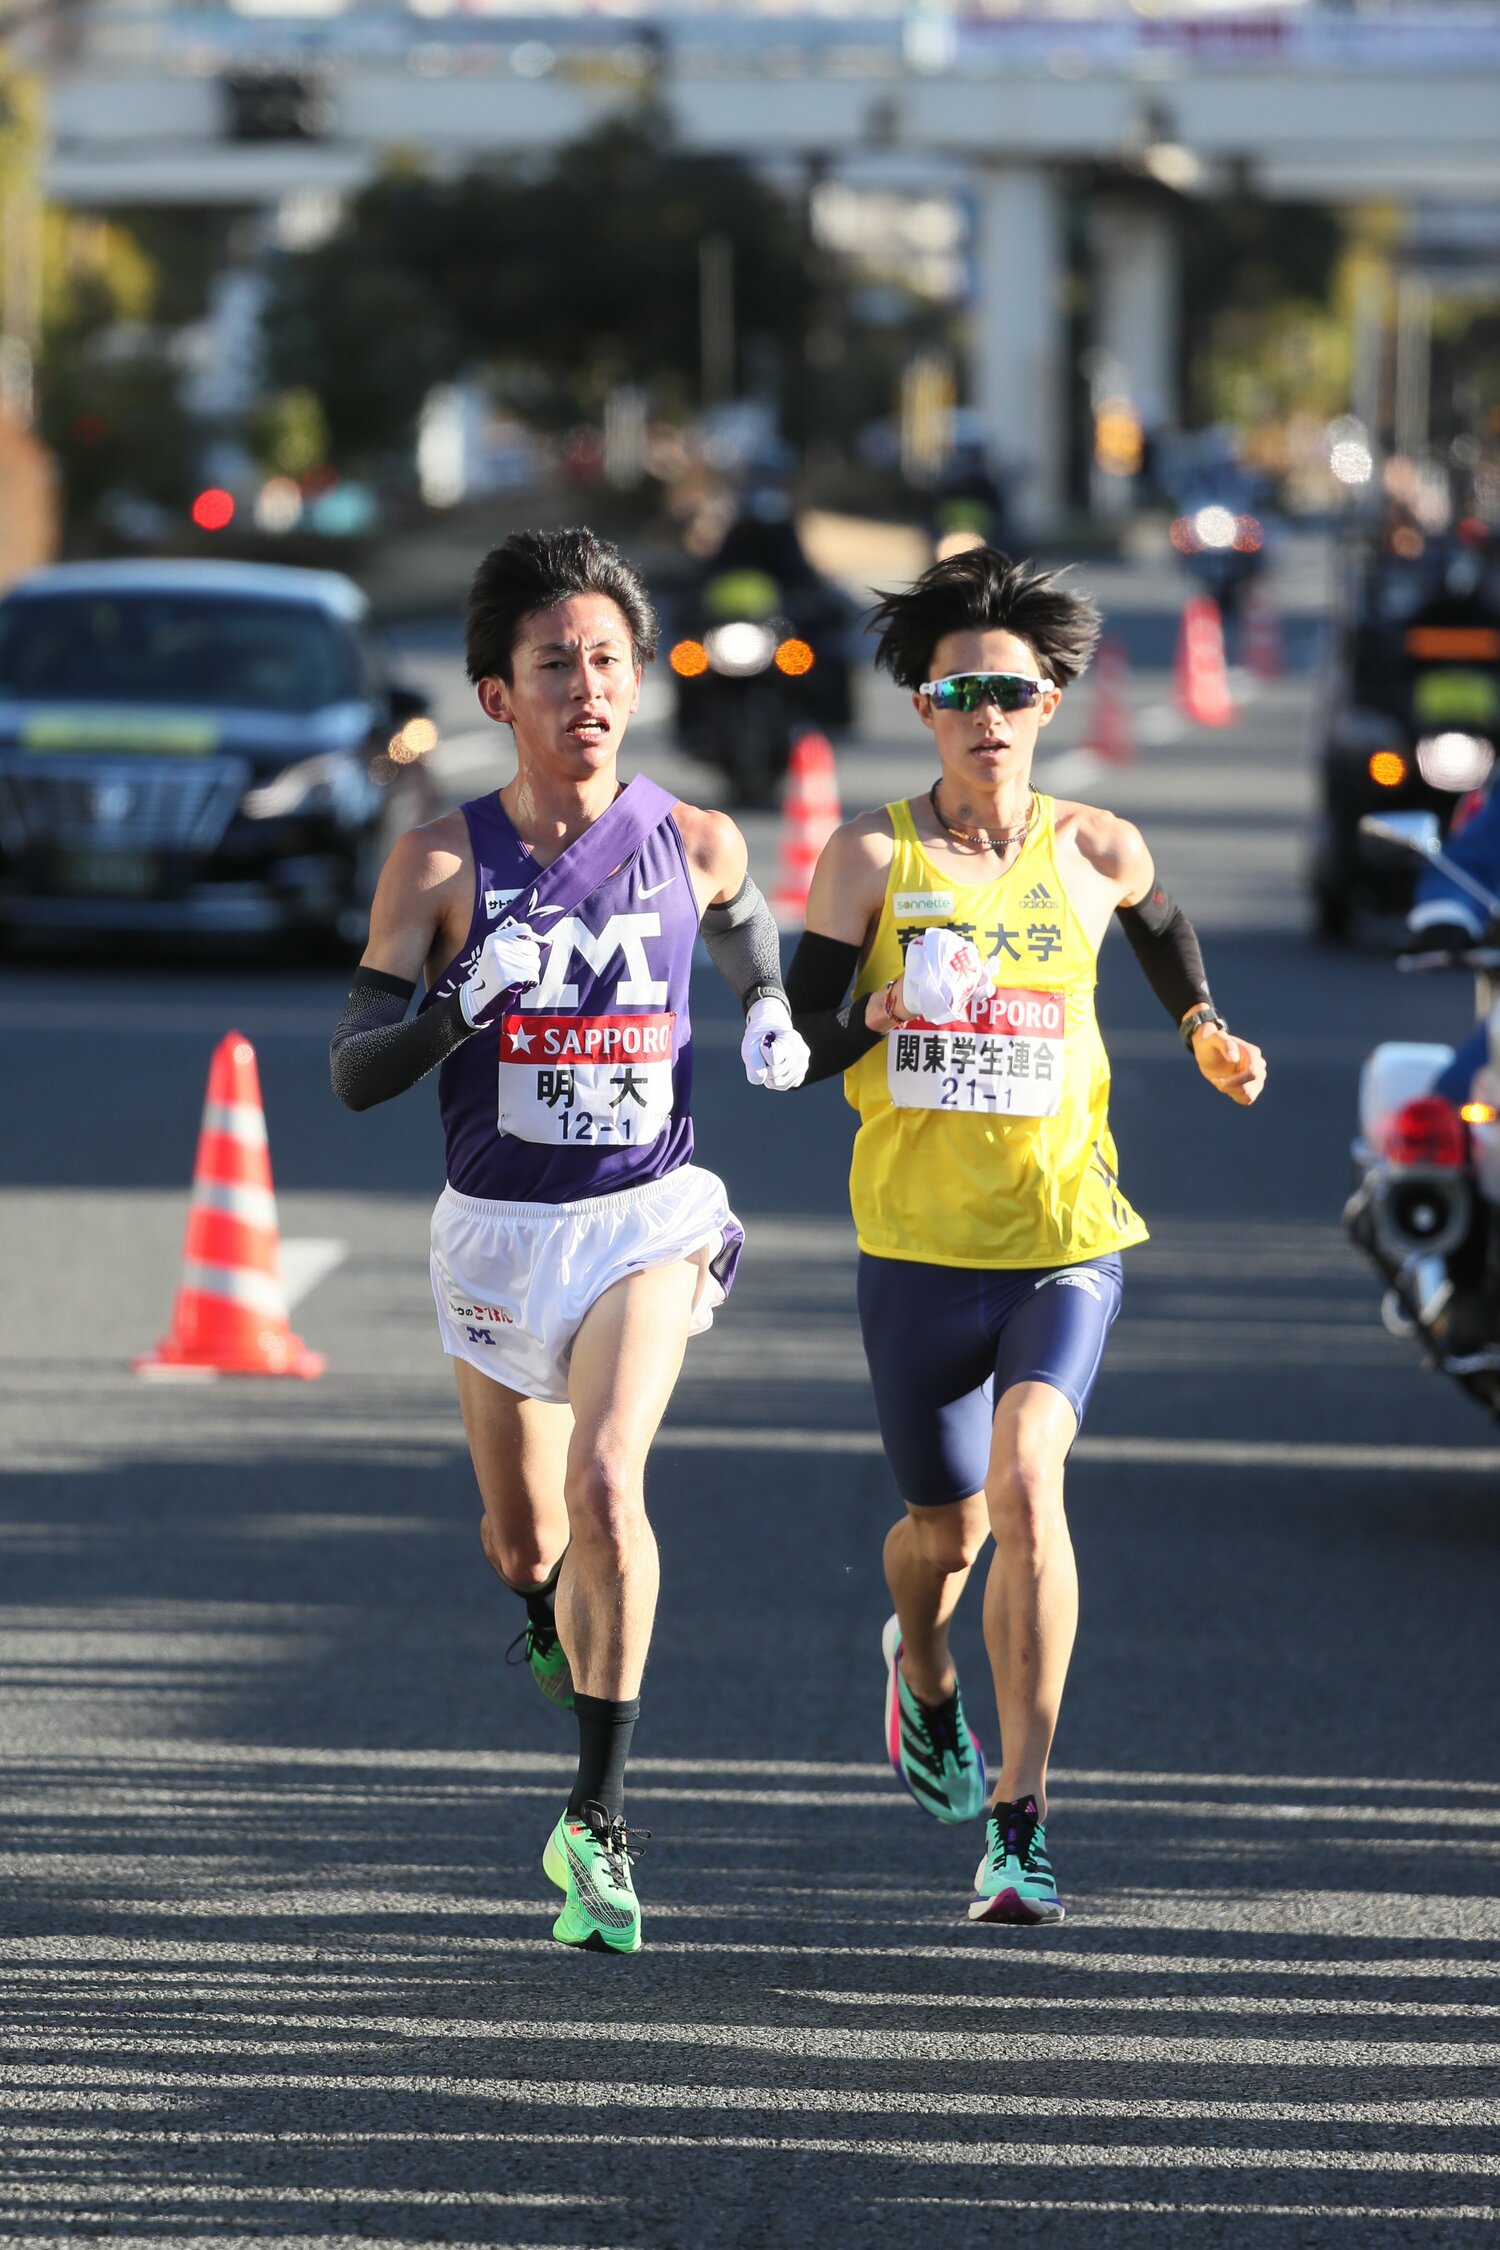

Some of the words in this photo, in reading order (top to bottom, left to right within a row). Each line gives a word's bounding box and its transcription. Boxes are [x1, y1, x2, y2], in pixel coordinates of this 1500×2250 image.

[896, 898, 950, 911] sonnette
[1018, 898, 1059, 909] adidas
[520, 912, 669, 1009] M
[960, 999, 1060, 1030] PPORO
[543, 1025, 669, 1055] SAPPORO
[895, 1034, 1055, 1081] 関東学生連合
[940, 1077, 1012, 1109] 21-1
[557, 1111, 631, 1140] 12-1
[466, 1326, 496, 1345] M
